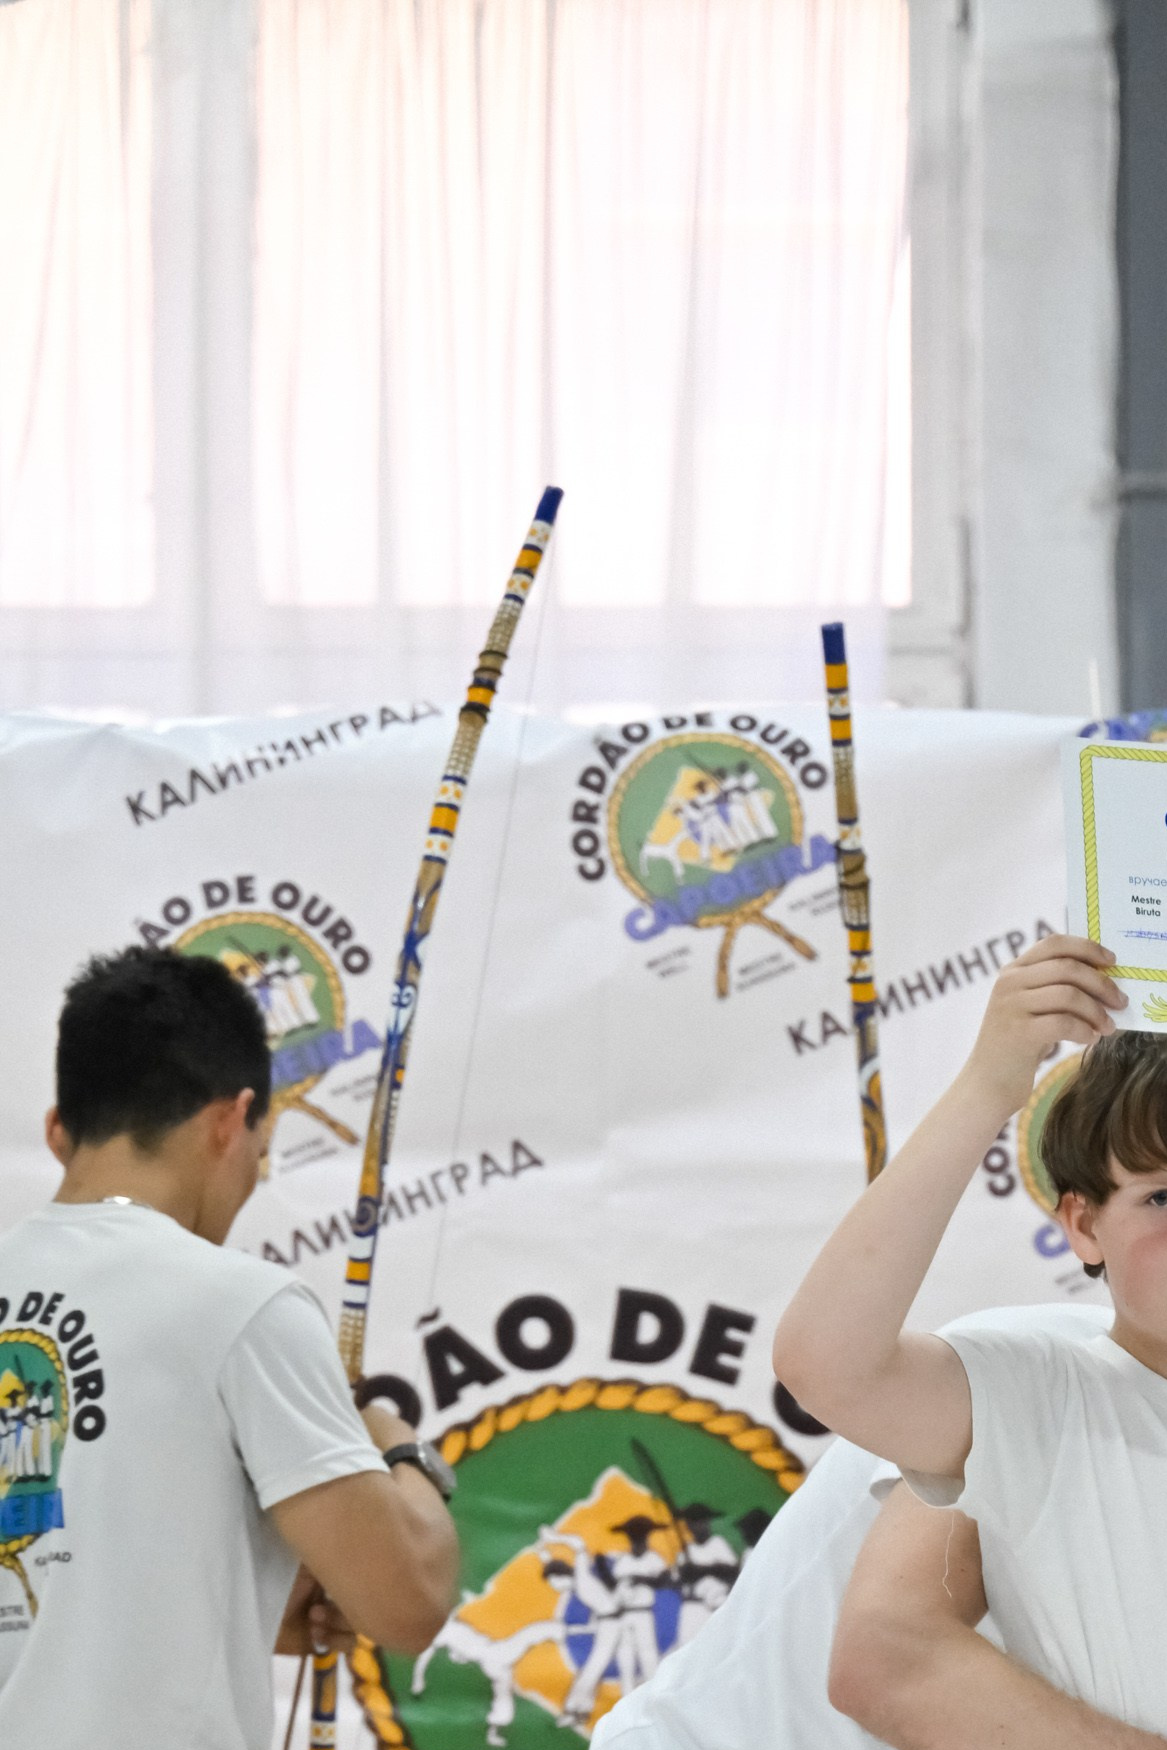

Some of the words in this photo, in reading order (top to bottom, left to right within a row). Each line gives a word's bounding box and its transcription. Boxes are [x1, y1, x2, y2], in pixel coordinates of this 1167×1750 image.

[572, 720, 651, 882] CORDÃO
[663, 712, 717, 731] DE
[729, 714, 829, 791] OURO
[201, 874, 257, 906] DE
[272, 881, 372, 977] OURO
[1131, 895, 1162, 906] Mestre
[1135, 907, 1161, 917] Biruta
[16, 1291, 65, 1326] DE
[57, 1309, 106, 1443] OURO
[609, 1286, 757, 1387] DE
